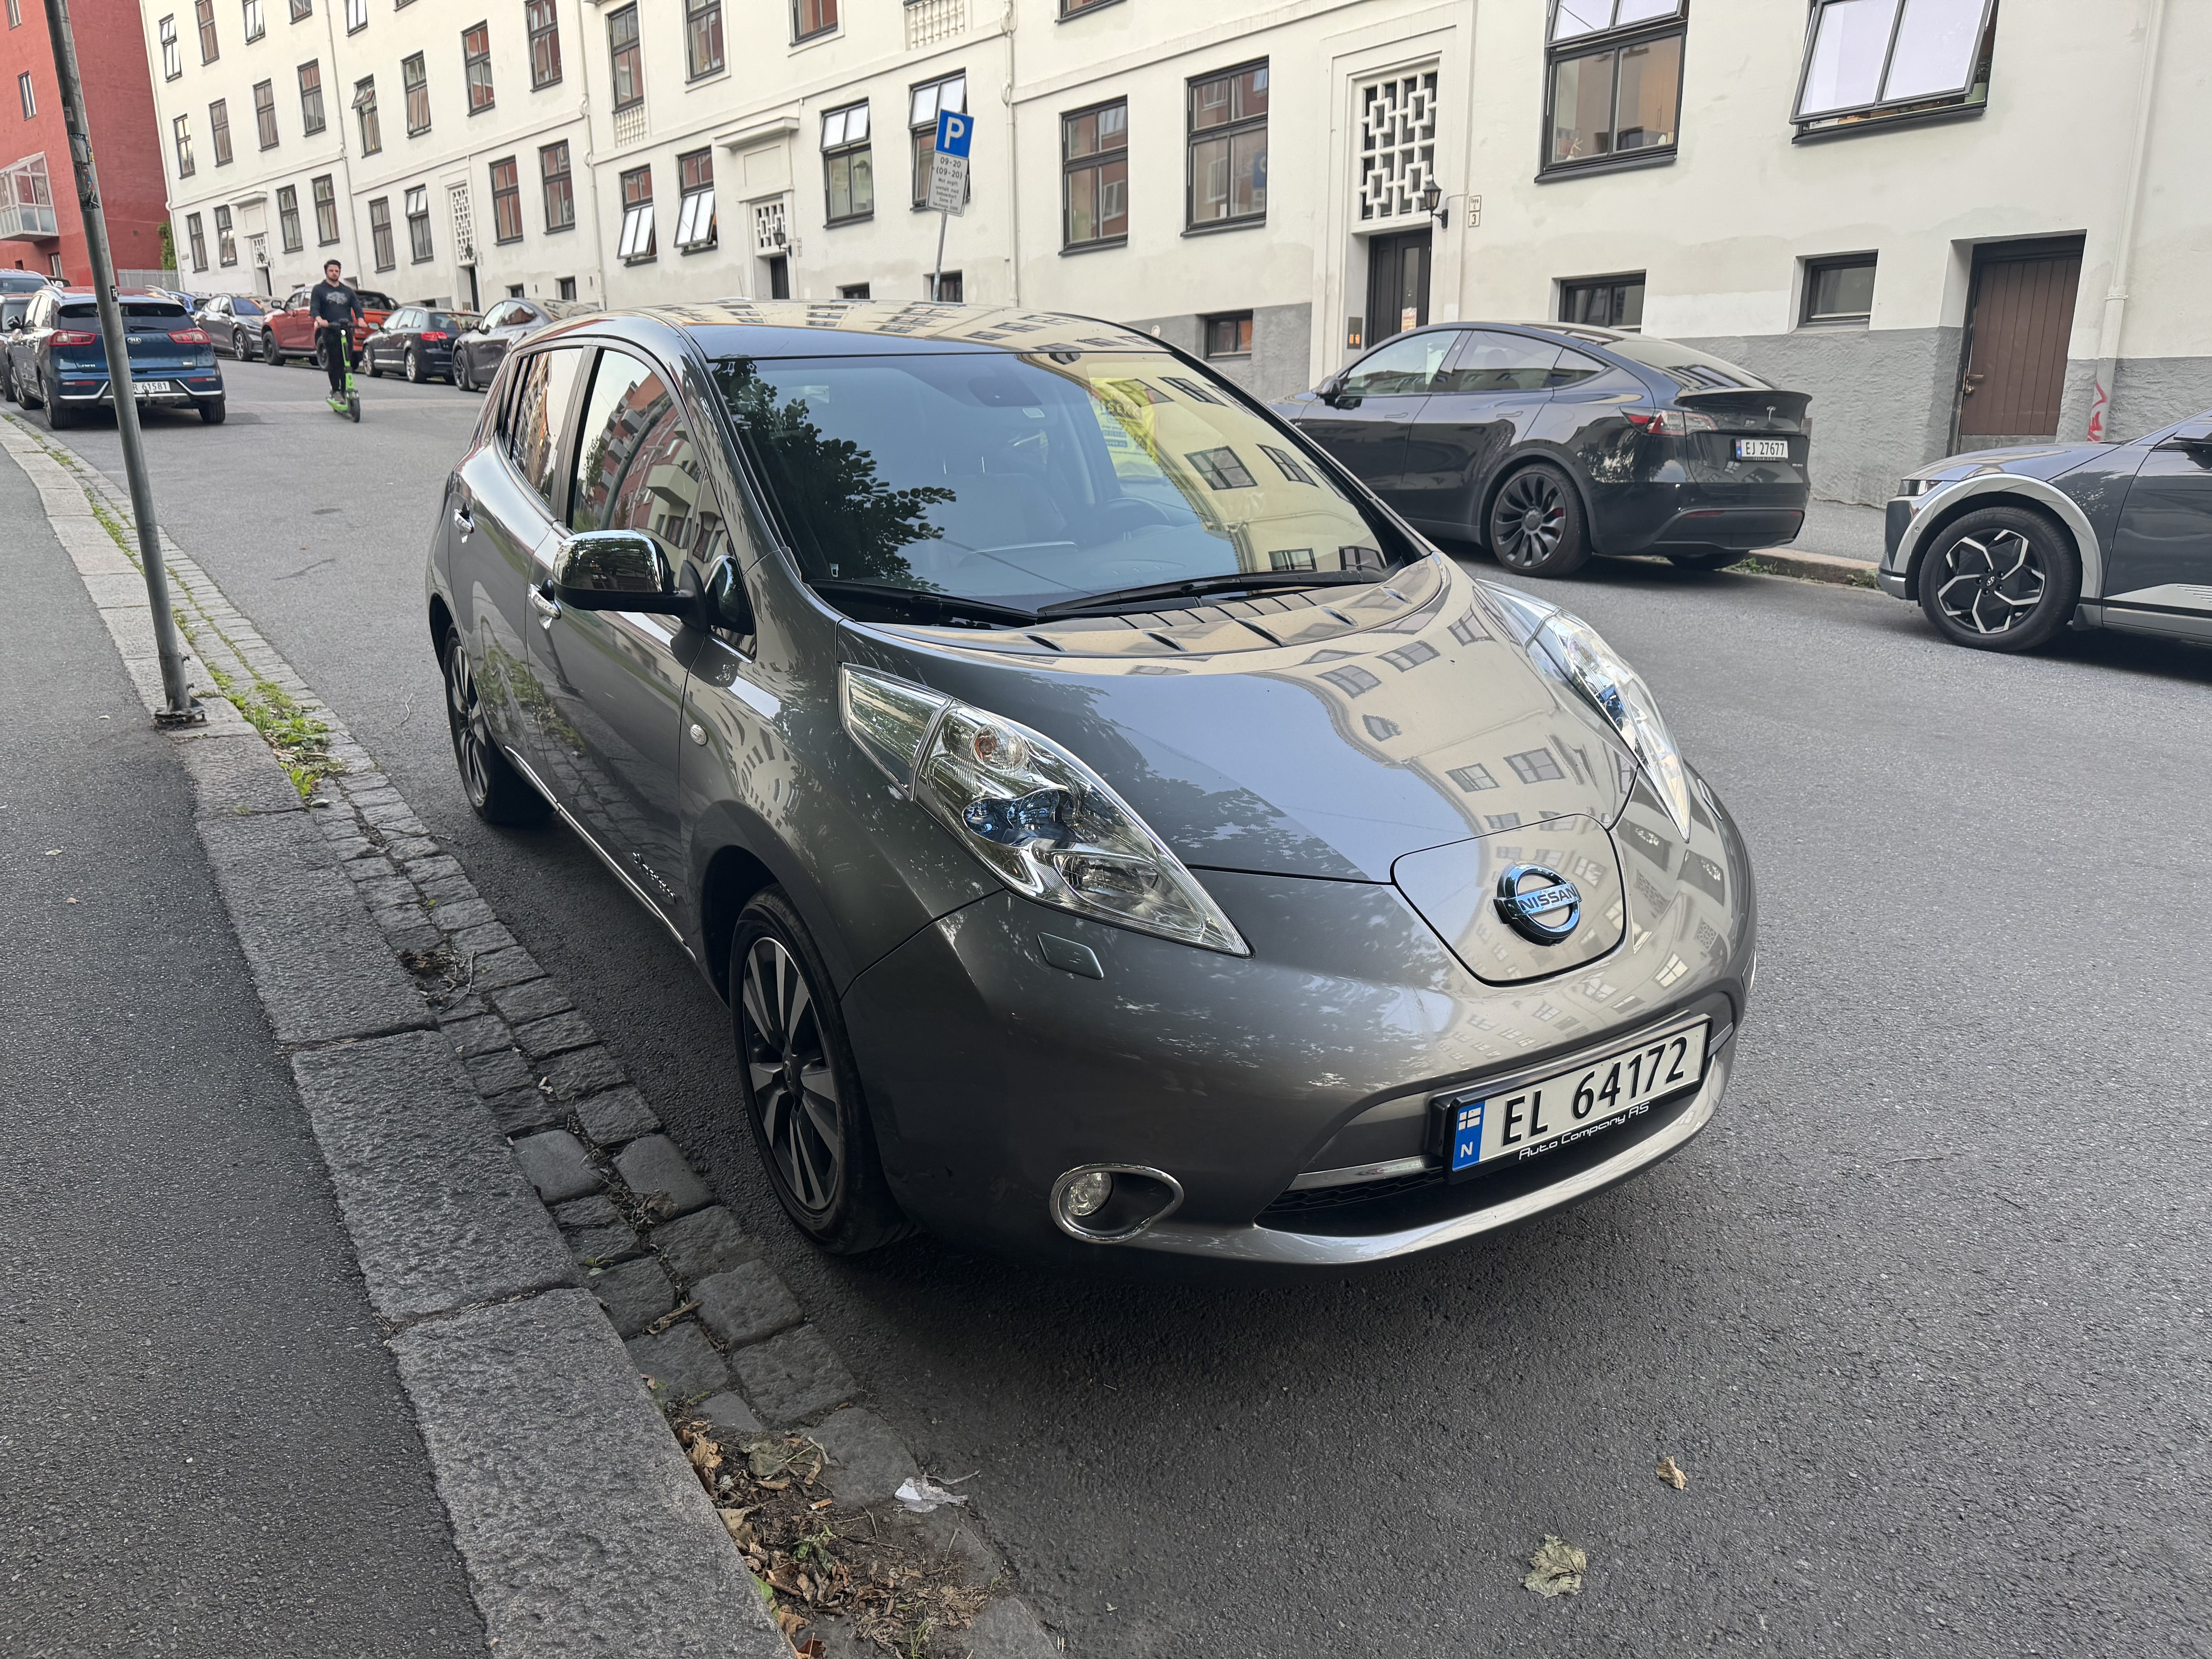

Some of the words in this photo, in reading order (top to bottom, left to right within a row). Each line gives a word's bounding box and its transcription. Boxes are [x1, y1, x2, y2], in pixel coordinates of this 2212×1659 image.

[944, 116, 964, 149] P
[1472, 214, 1476, 224] 3
[1746, 442, 1755, 455] EJ
[1760, 442, 1784, 456] 27677
[1518, 887, 1577, 910] NISSAN
[1501, 1089, 1548, 1146] EL
[1571, 1036, 1687, 1119] 64172
[1519, 1141, 1558, 1160] Auto
[1561, 1114, 1626, 1144] Company
[1628, 1101, 1650, 1118] AS
[1460, 1141, 1473, 1158] N
